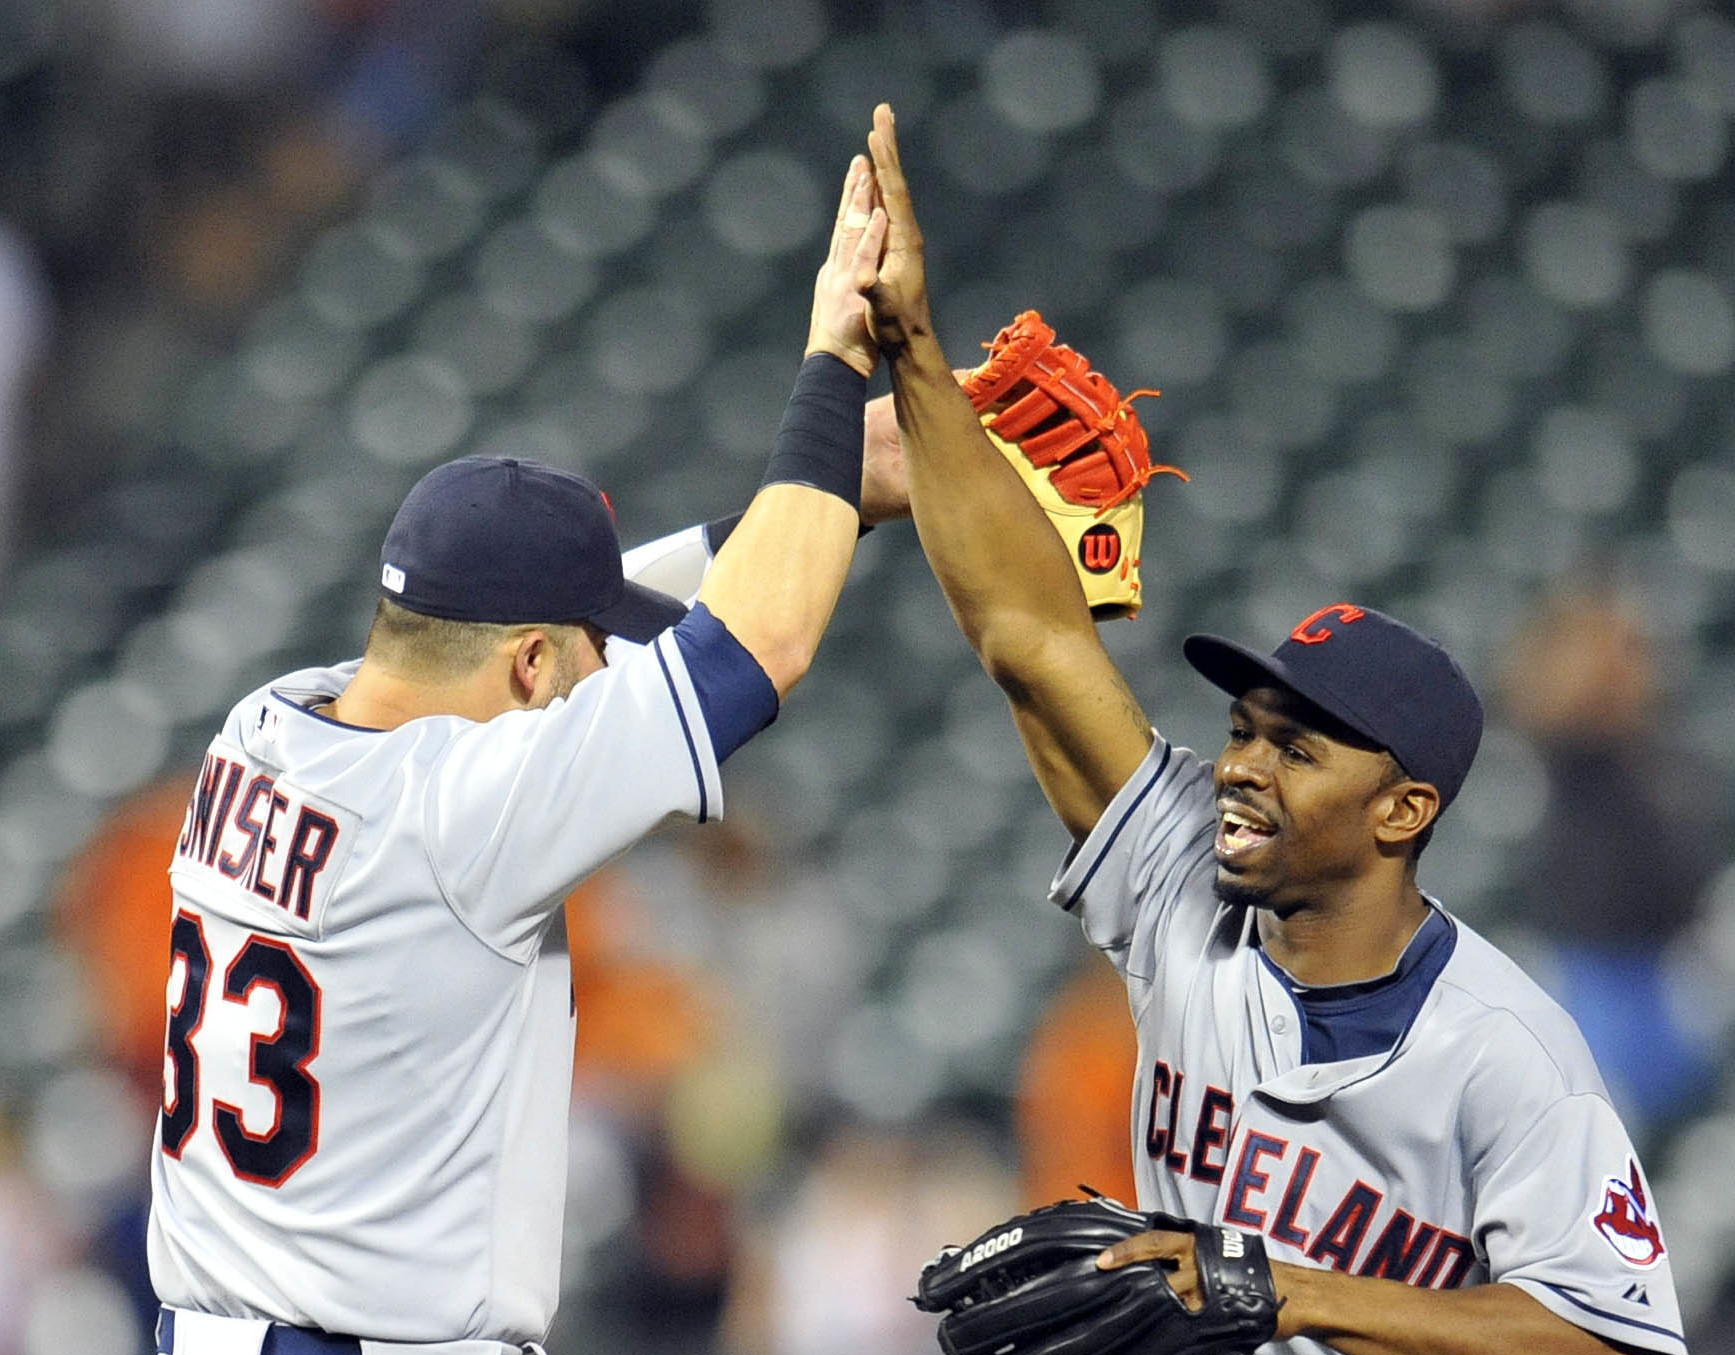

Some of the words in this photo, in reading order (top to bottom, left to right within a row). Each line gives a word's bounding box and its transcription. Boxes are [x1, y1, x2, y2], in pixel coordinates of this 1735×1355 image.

[1291, 602, 1364, 645] C
[162, 908, 323, 1189] 33
[1146, 1059, 1476, 1289] CLEELAND
[960, 1227, 1023, 1272] A2000
